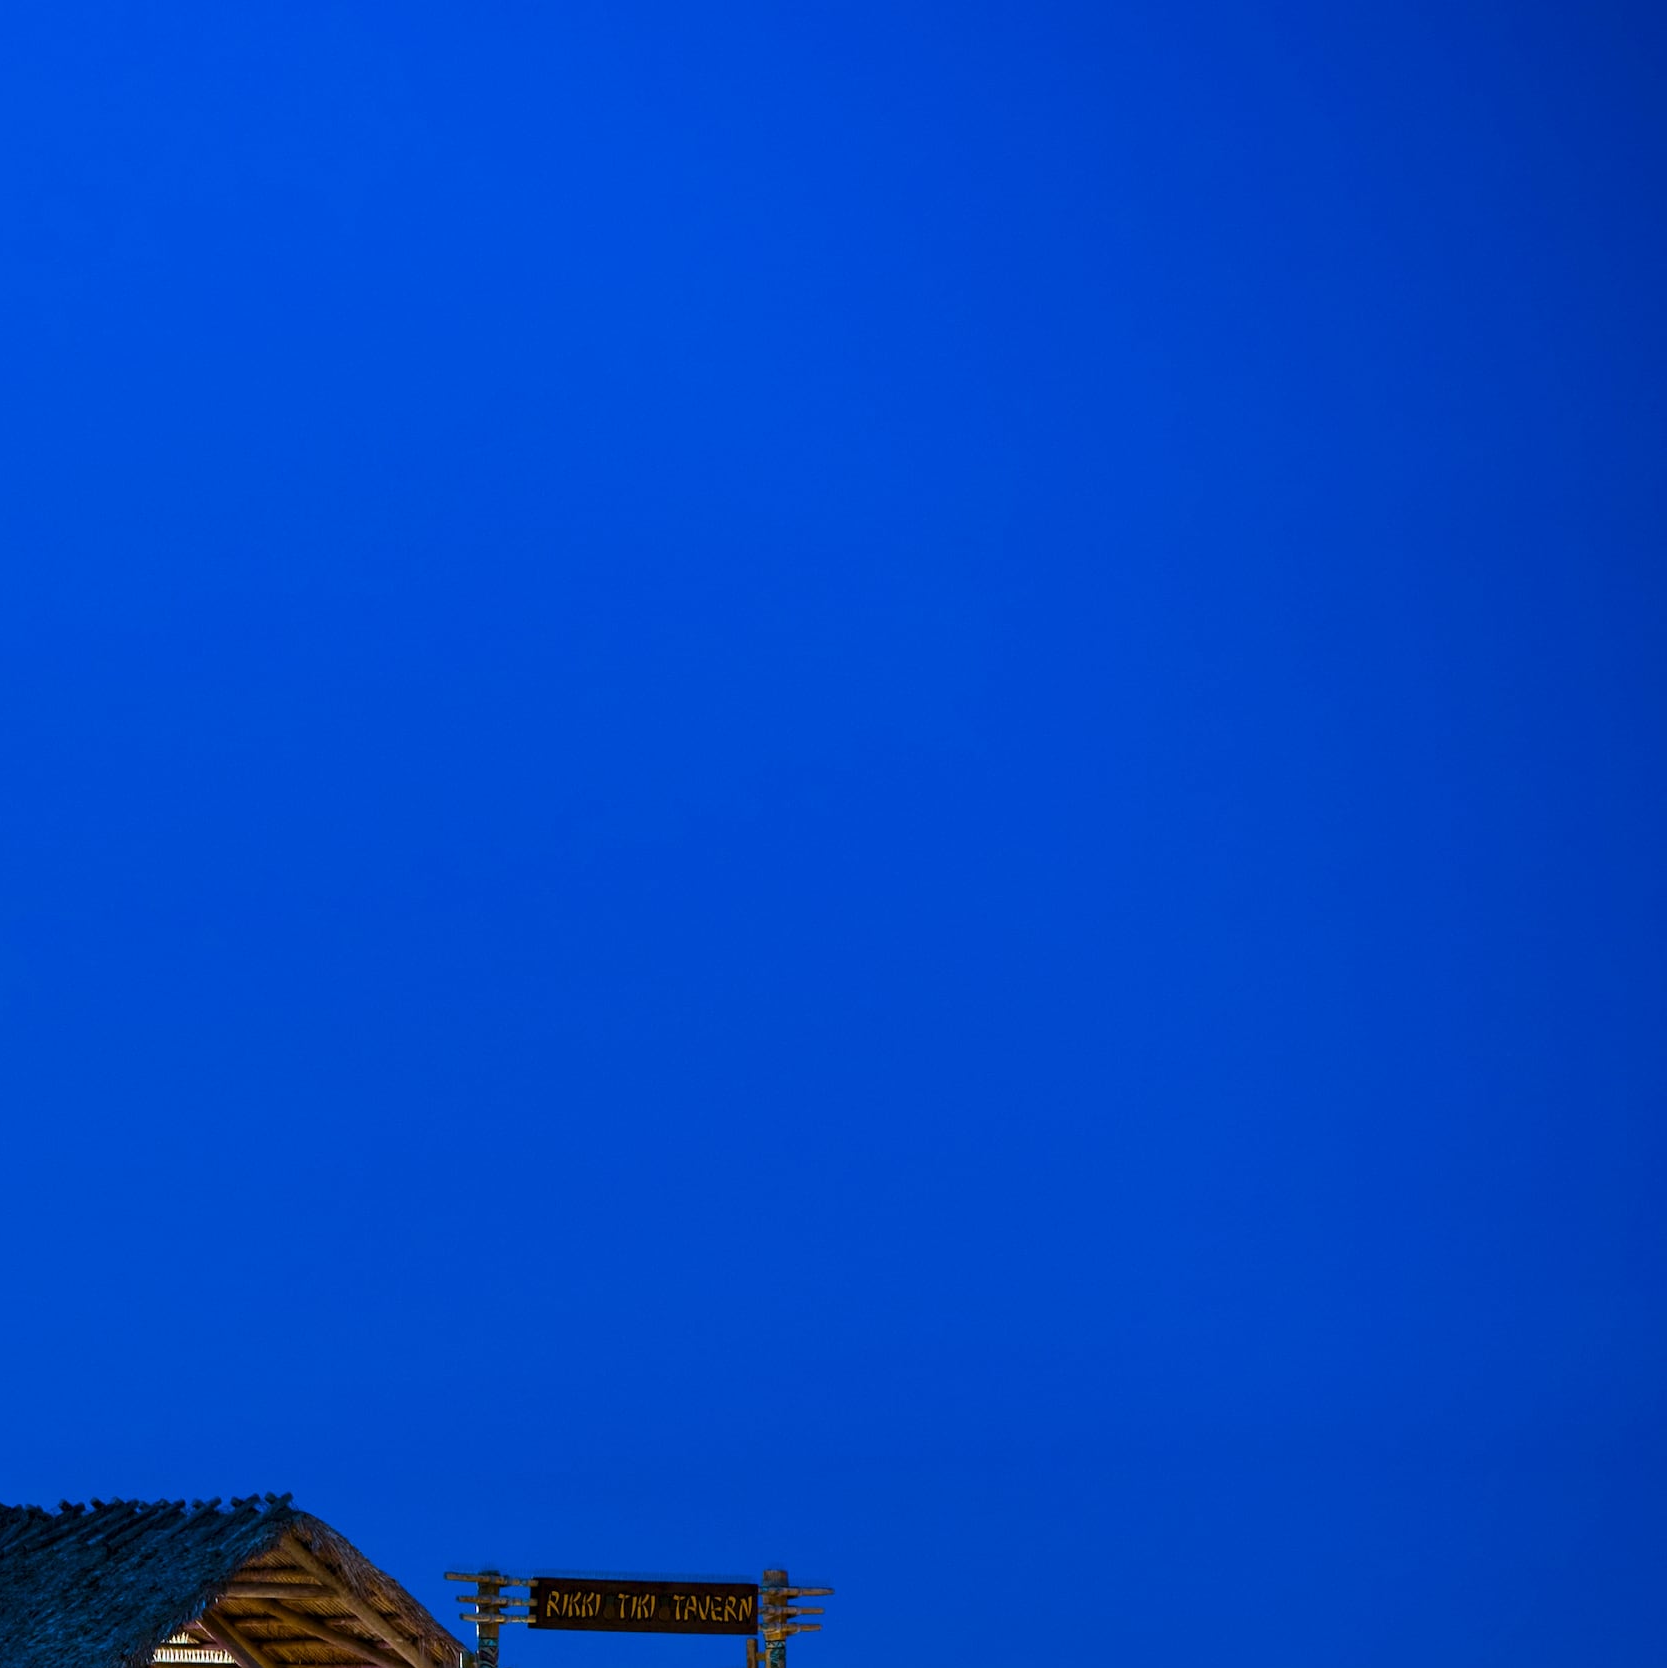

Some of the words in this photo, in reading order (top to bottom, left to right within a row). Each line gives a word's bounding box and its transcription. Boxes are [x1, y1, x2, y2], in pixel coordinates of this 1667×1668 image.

[546, 1590, 601, 1617] RIKKI
[618, 1593, 656, 1620] TIKI
[672, 1594, 753, 1622] TAVERN
